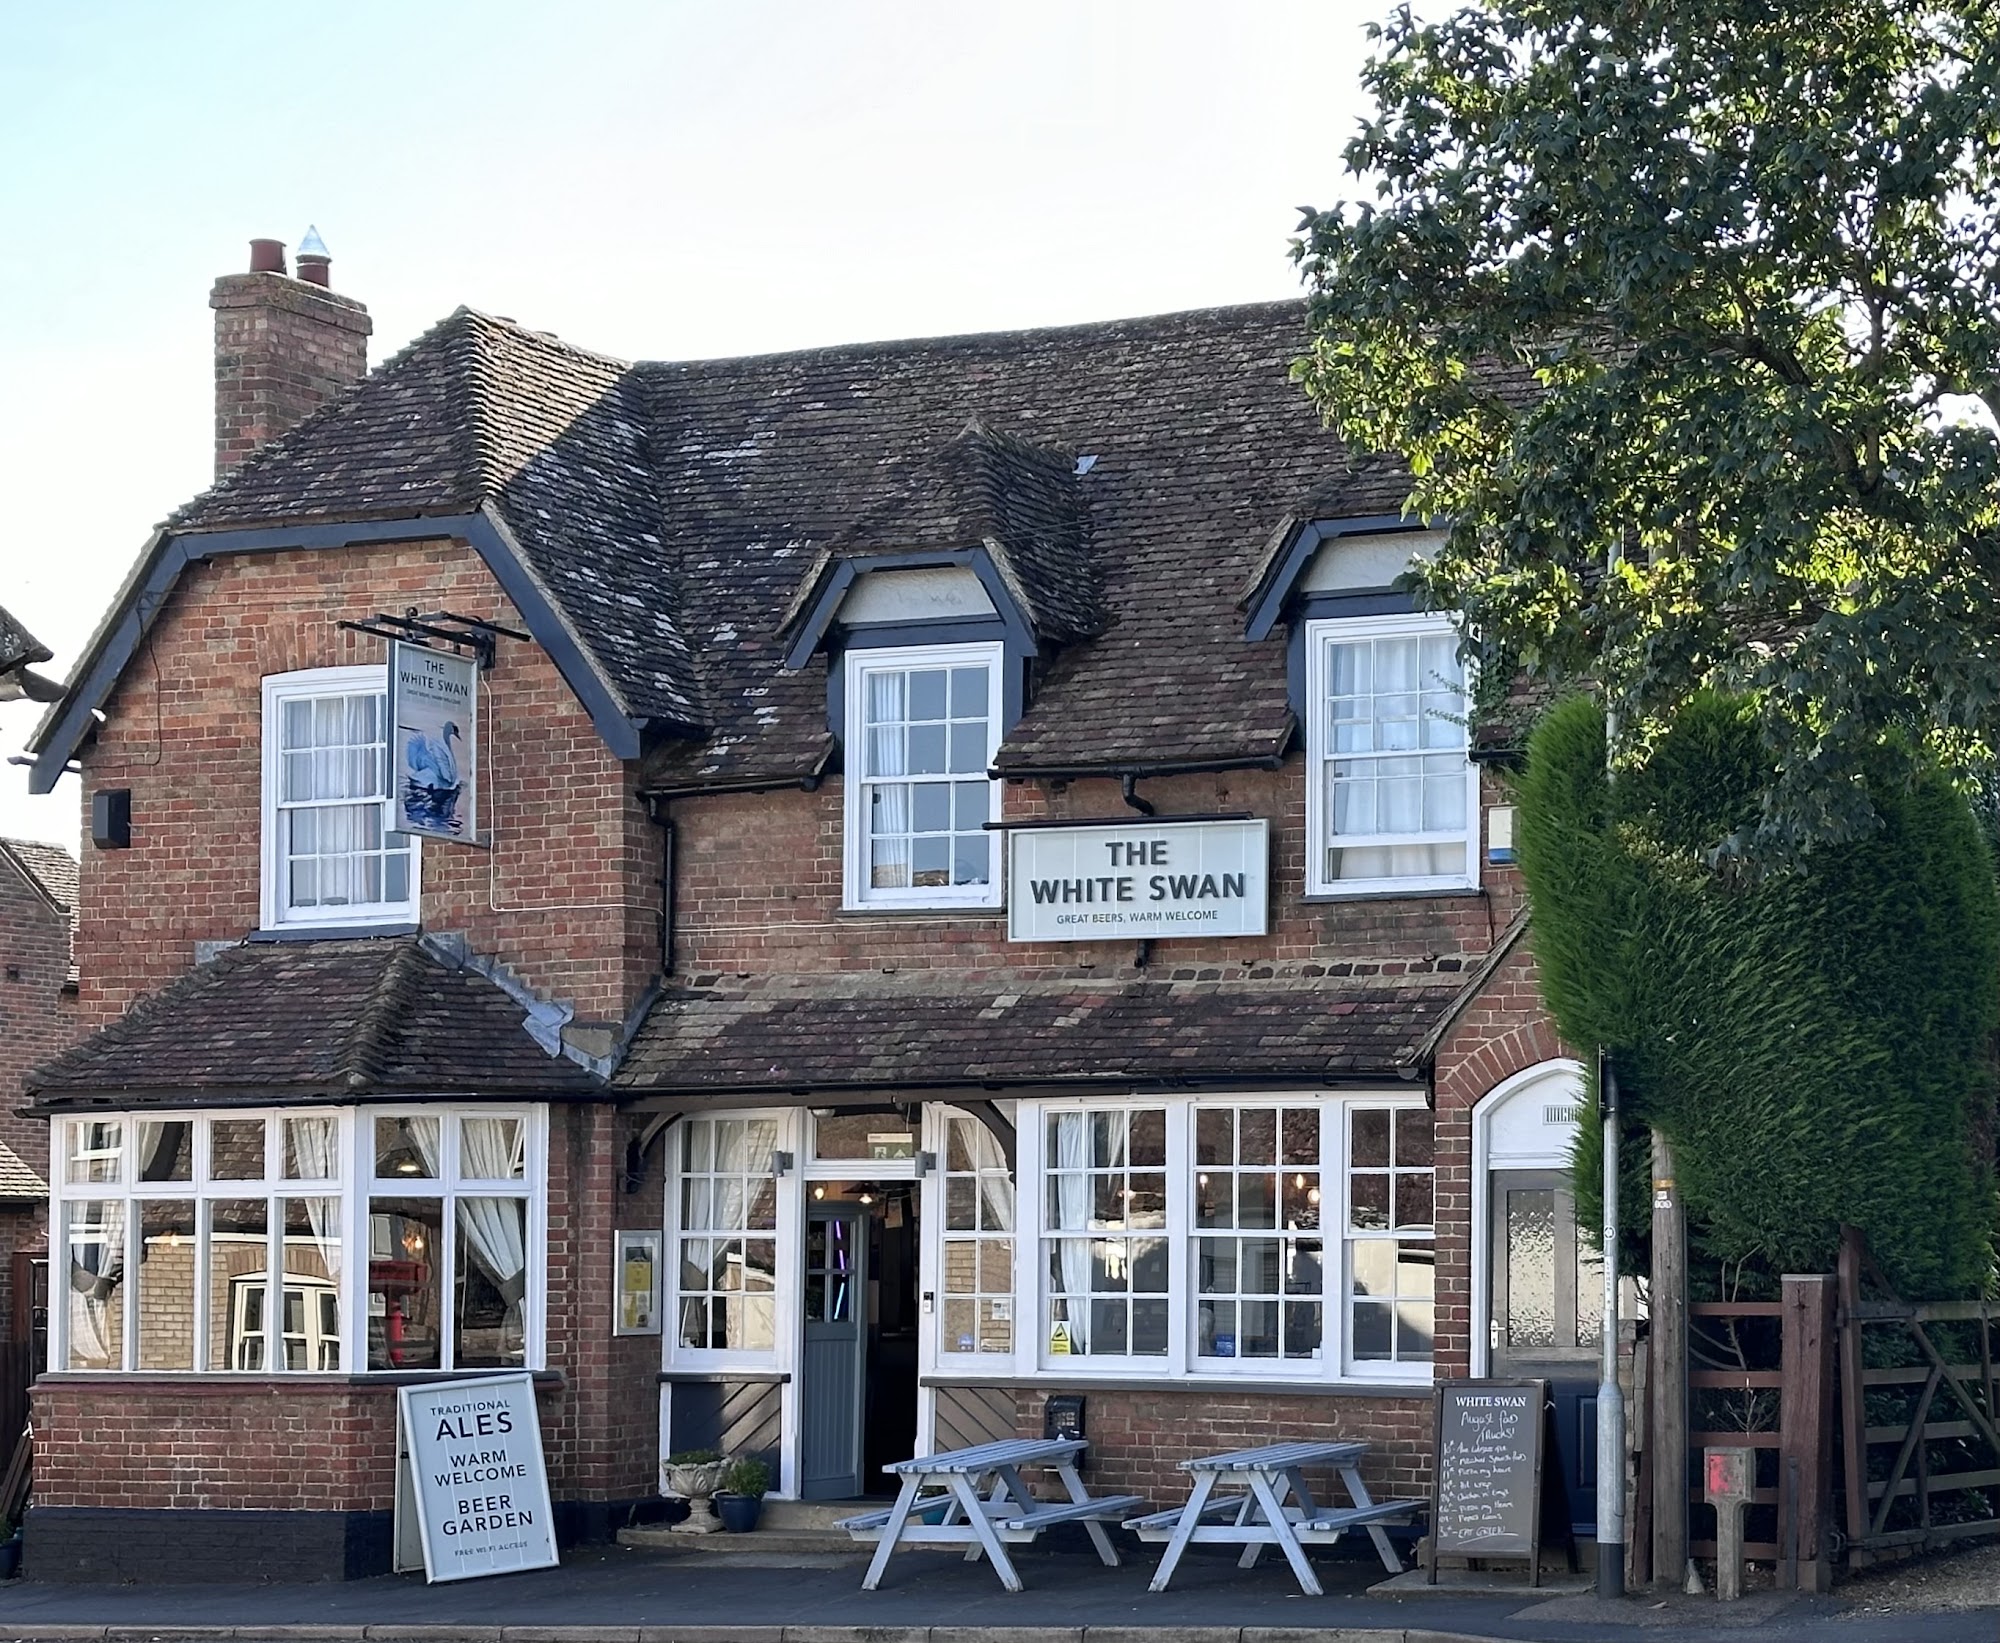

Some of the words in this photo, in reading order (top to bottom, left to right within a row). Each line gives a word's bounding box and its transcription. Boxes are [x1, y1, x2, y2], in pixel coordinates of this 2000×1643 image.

[424, 660, 445, 675] THE
[400, 671, 434, 689] WHITE
[438, 680, 468, 697] SWAN
[1105, 840, 1168, 866] THE
[1030, 876, 1133, 904] WHITE
[1149, 872, 1245, 901] SWAN
[1056, 914, 1089, 925] GREAT
[1092, 912, 1126, 924] BEERS,
[1129, 911, 1162, 922] WARM
[1165, 910, 1218, 921] WELCOME
[430, 1400, 511, 1416] TRADITIONAL
[1456, 1396, 1493, 1408] WHITE
[1494, 1396, 1526, 1407] SWAN
[436, 1411, 513, 1441] ALES
[450, 1449, 507, 1468] WARM
[434, 1464, 527, 1487] WELCOME
[458, 1495, 512, 1515] BEER
[443, 1510, 533, 1535] GARDEN
